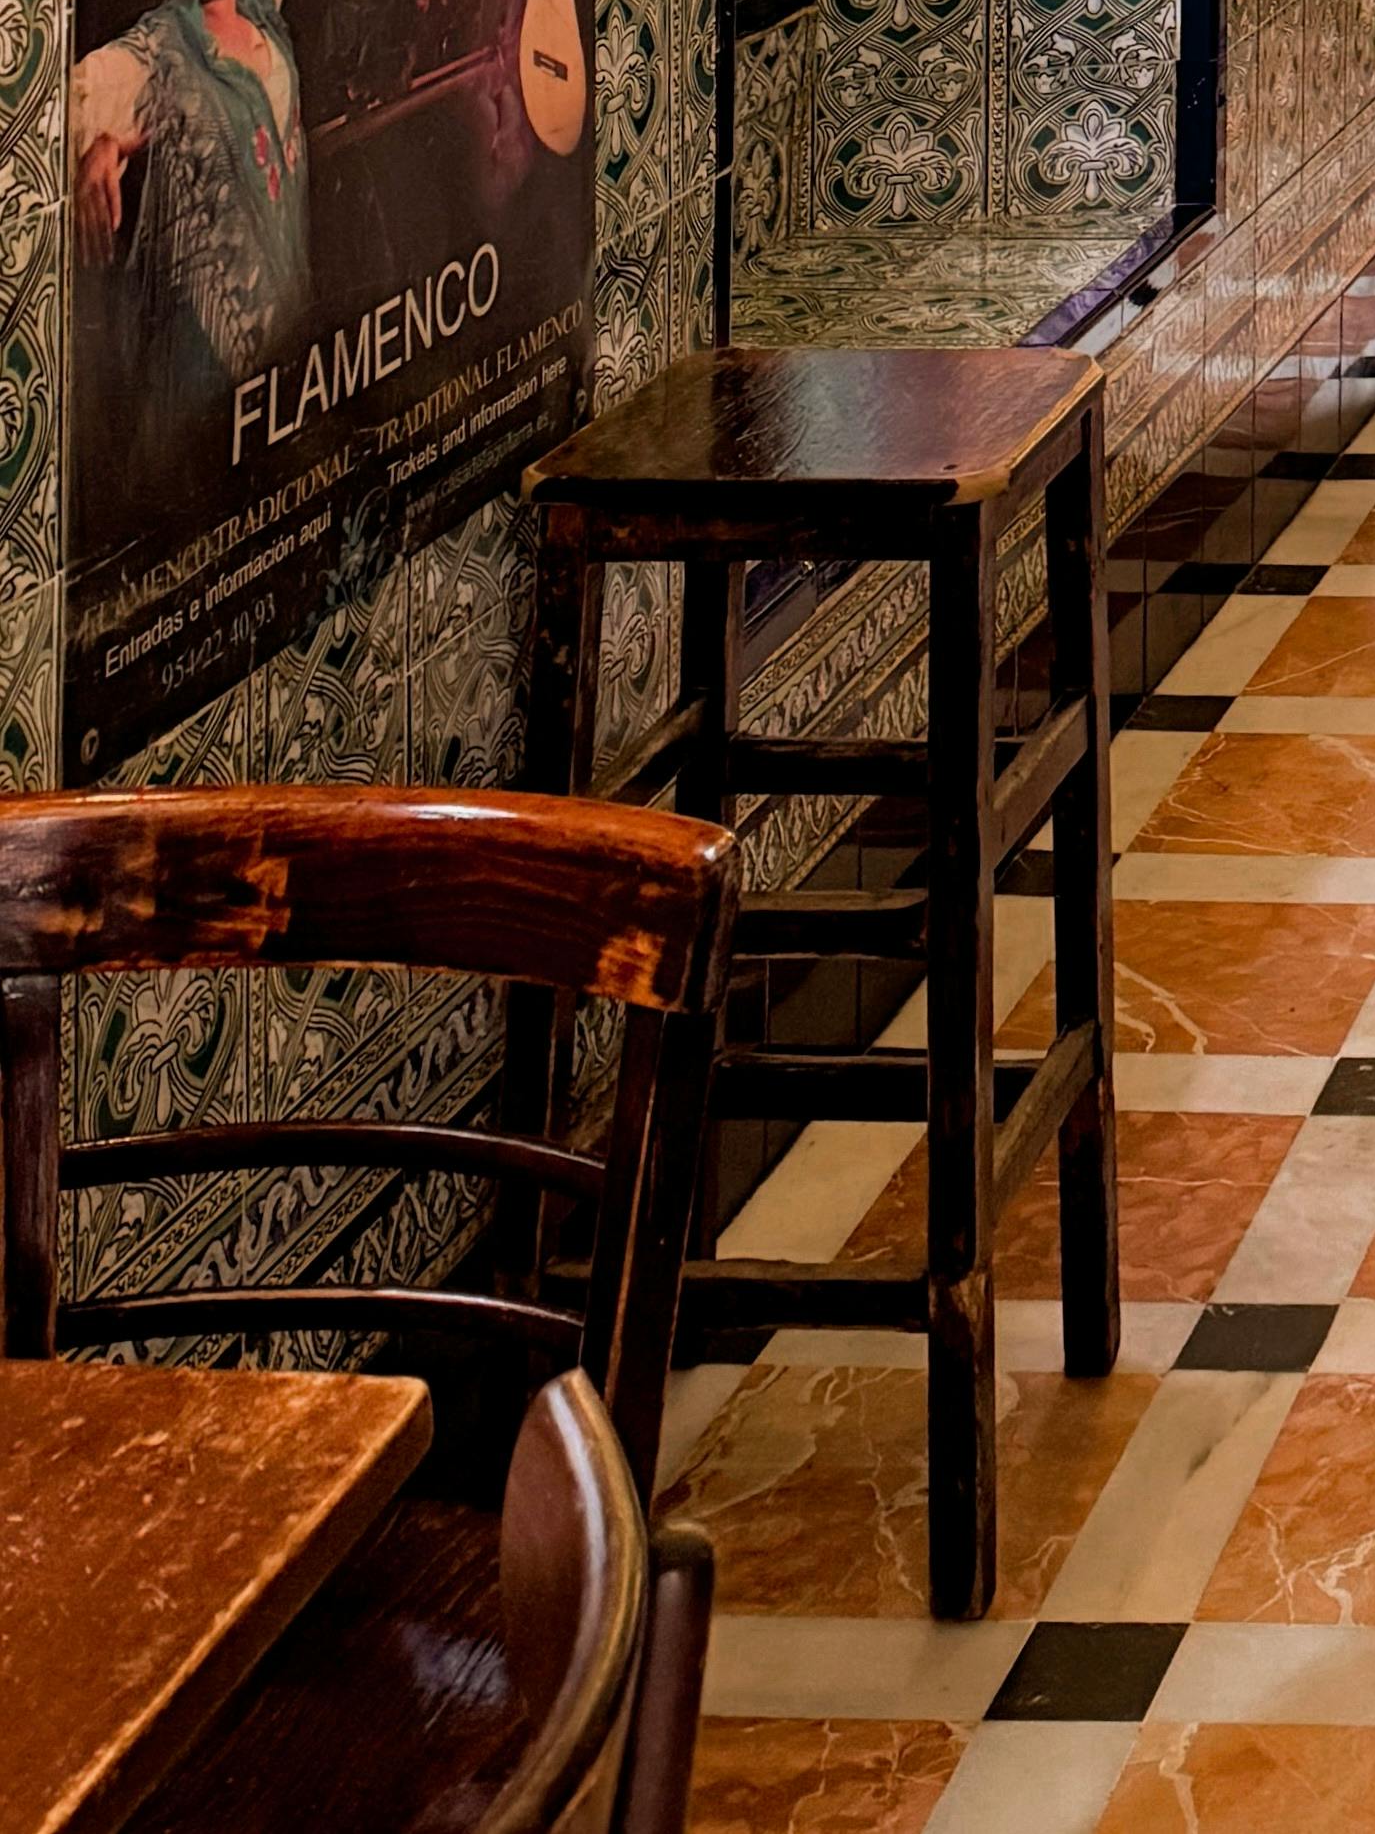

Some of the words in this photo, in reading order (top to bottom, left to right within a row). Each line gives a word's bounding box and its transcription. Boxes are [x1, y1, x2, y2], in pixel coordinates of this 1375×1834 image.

[231, 242, 500, 467] FLAMENCO
[375, 357, 493, 455] TRADITIONAL
[496, 298, 584, 378] FLAMENCO
[387, 442, 439, 486] Tickets
[442, 420, 466, 455] and
[469, 374, 538, 434] information
[541, 355, 568, 389] here
[105, 608, 184, 678] Entradas
[189, 597, 200, 623] e
[204, 533, 296, 612] información
[254, 592, 277, 627] 93
